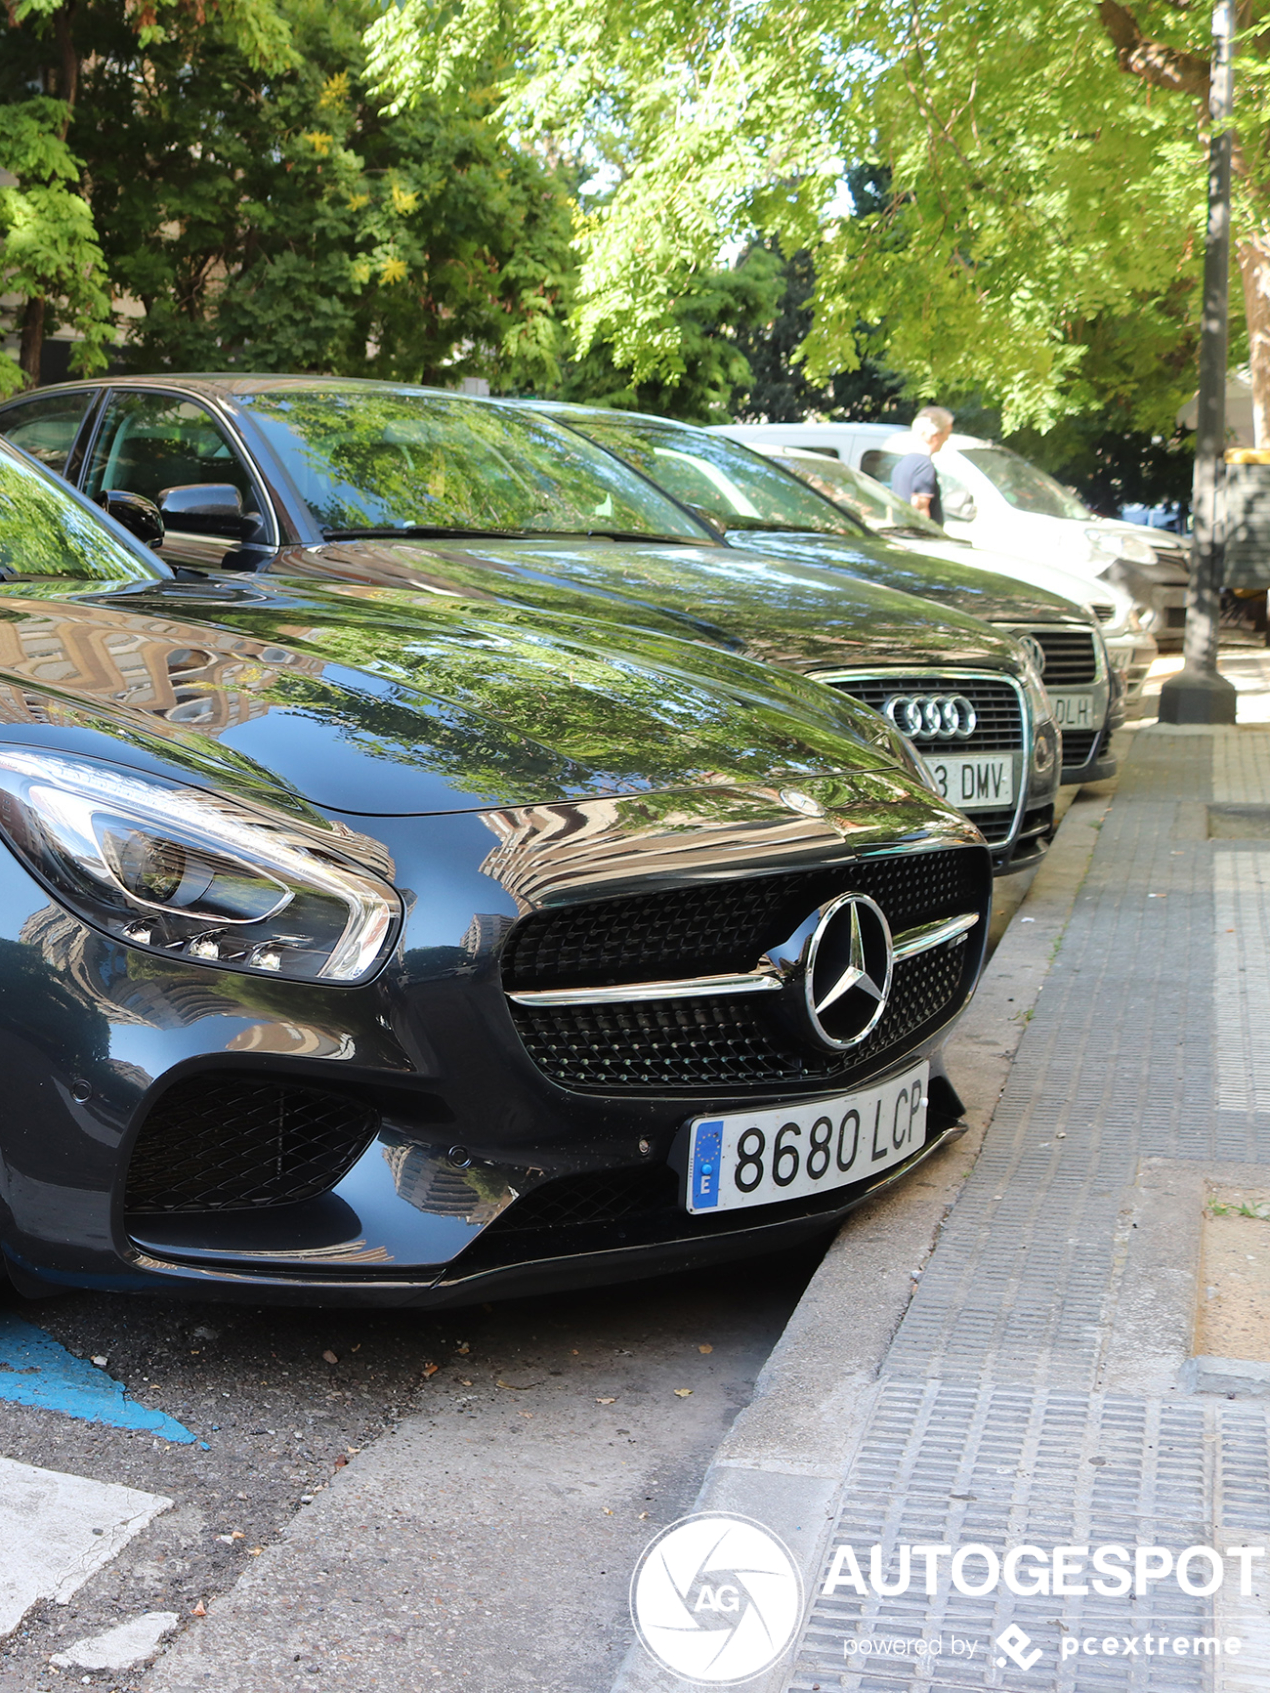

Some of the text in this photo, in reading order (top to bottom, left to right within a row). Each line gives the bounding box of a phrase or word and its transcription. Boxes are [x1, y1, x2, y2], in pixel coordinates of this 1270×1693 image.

[1055, 699, 1088, 724] DLH
[962, 763, 1003, 799] DMV
[734, 1079, 922, 1193] 8680 LCP
[700, 1175, 712, 1195] E
